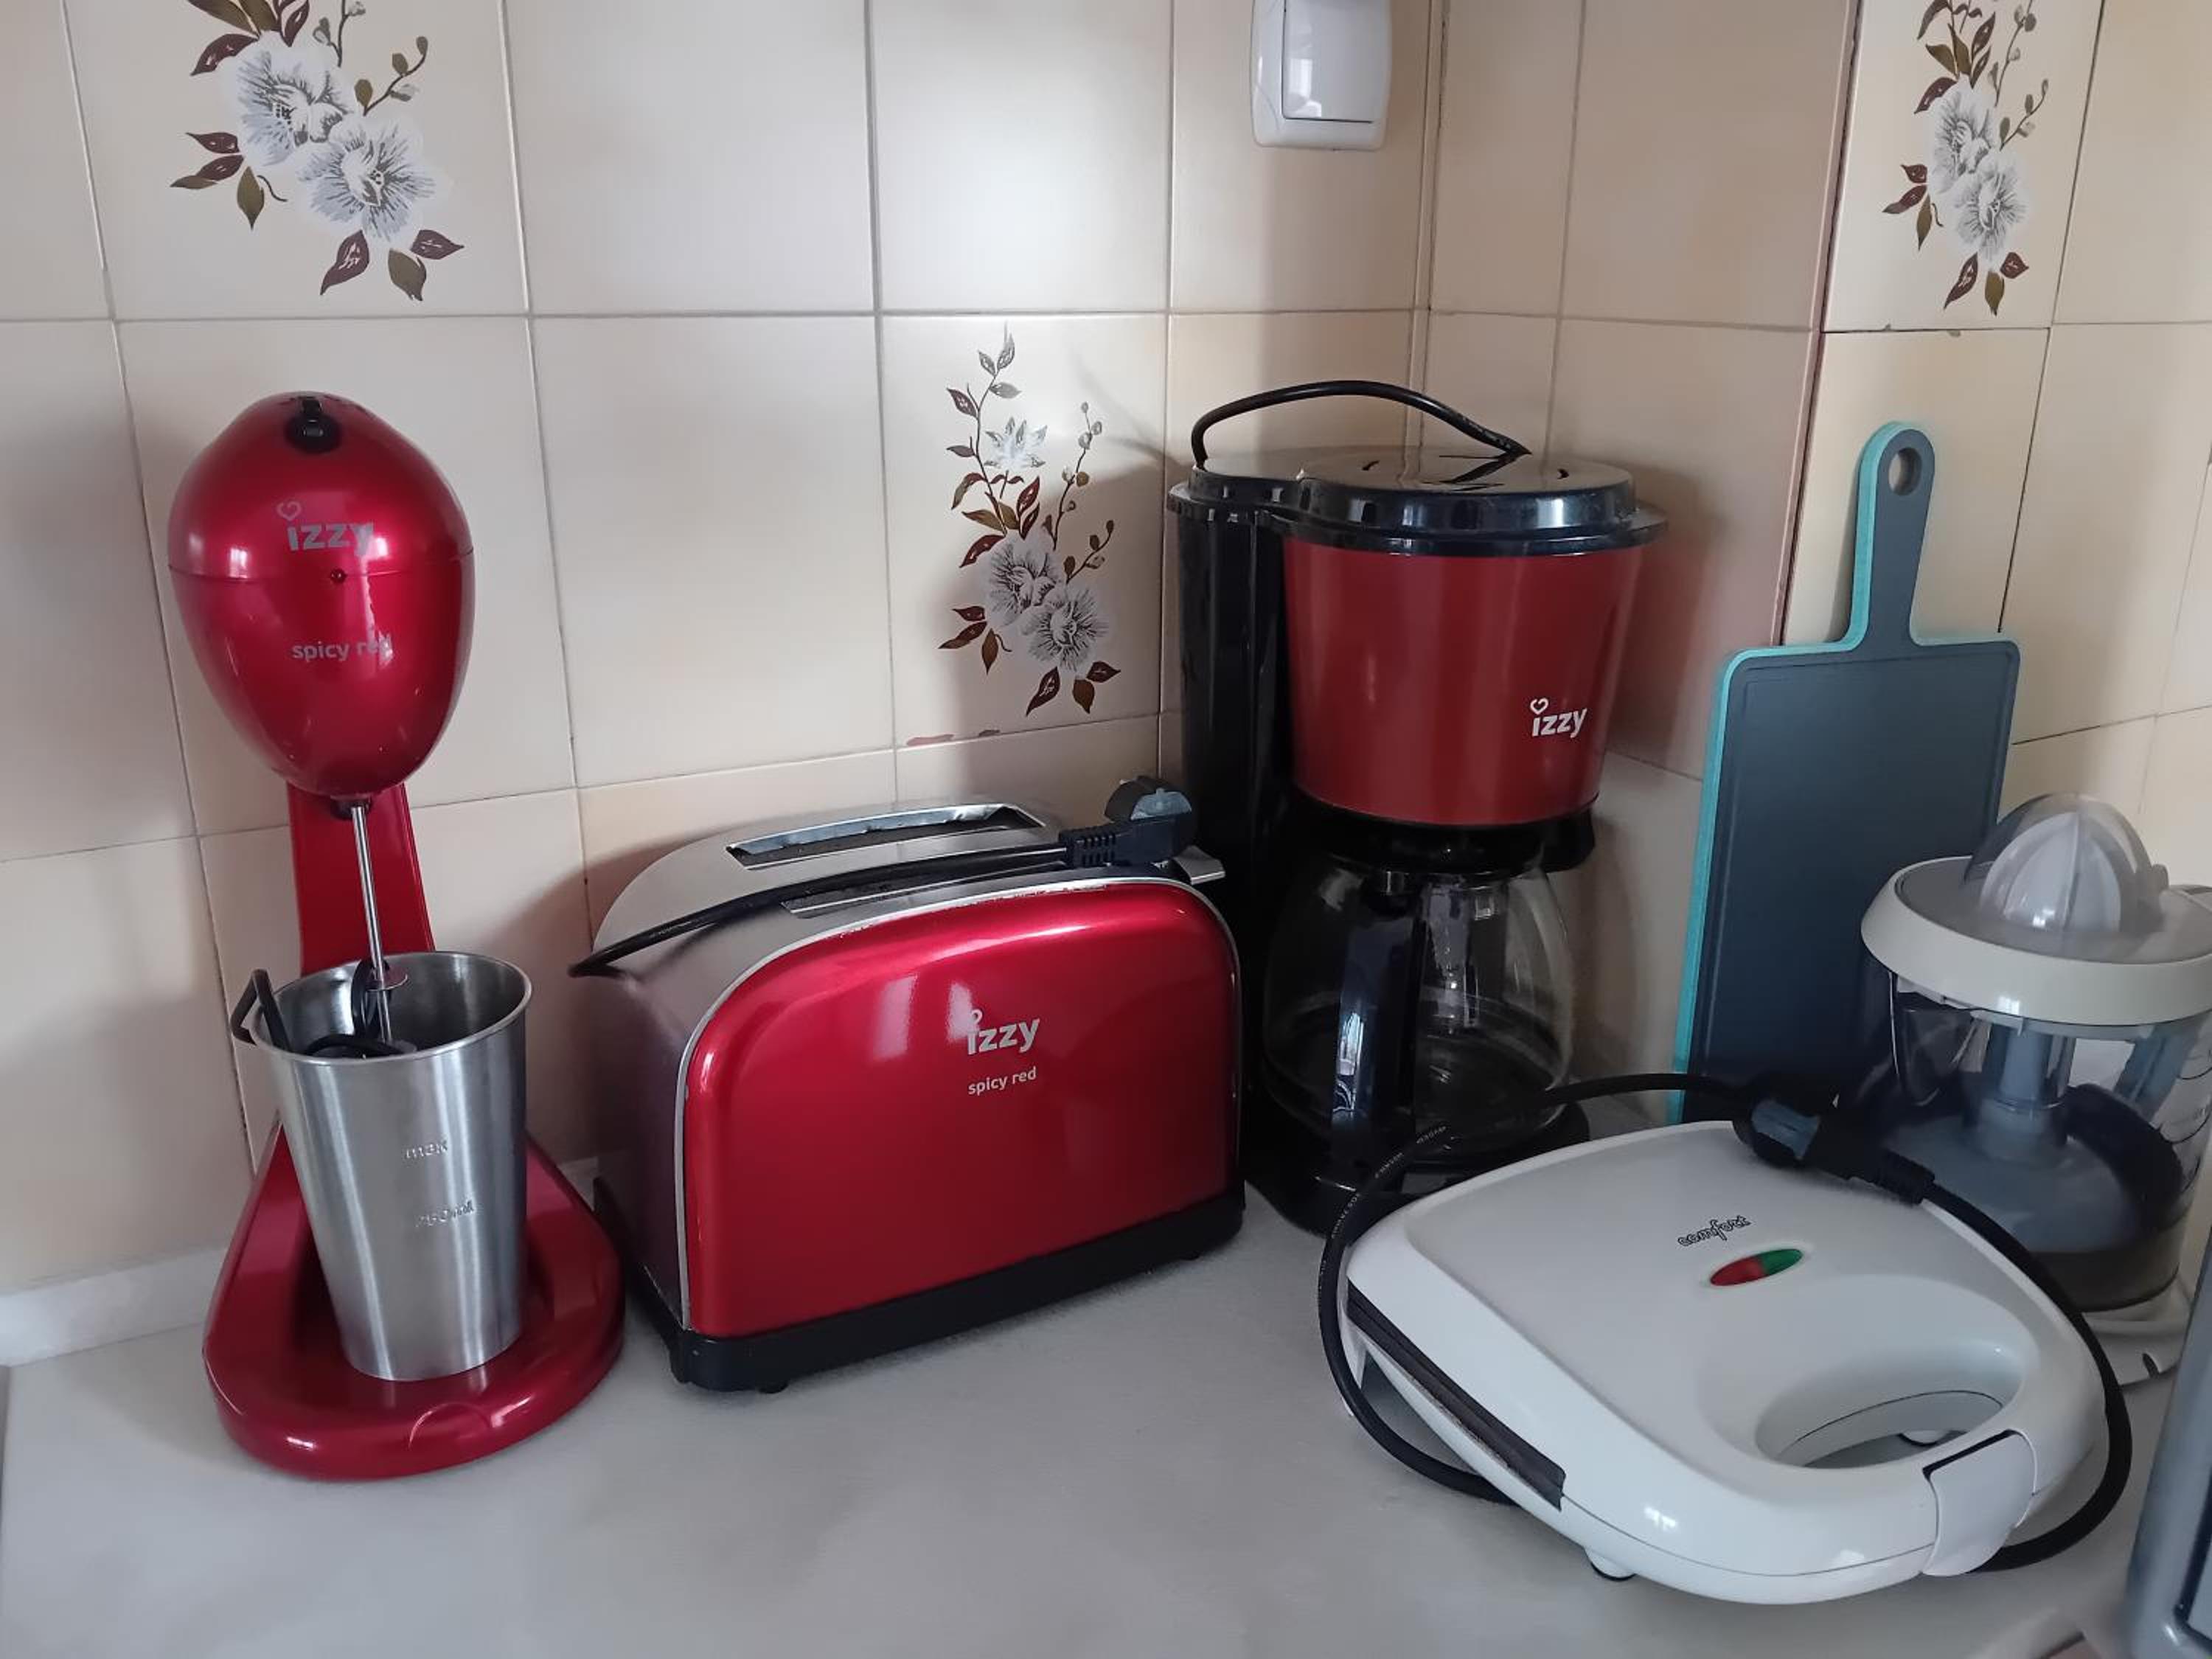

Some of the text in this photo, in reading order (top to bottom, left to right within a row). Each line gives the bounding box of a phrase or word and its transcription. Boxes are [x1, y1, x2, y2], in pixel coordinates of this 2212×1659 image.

[276, 501, 375, 557] izzy
[291, 641, 349, 662] spicy
[1530, 697, 1587, 738] izzy
[967, 1009, 1040, 1055] izzy
[967, 1065, 1037, 1096] spicy red
